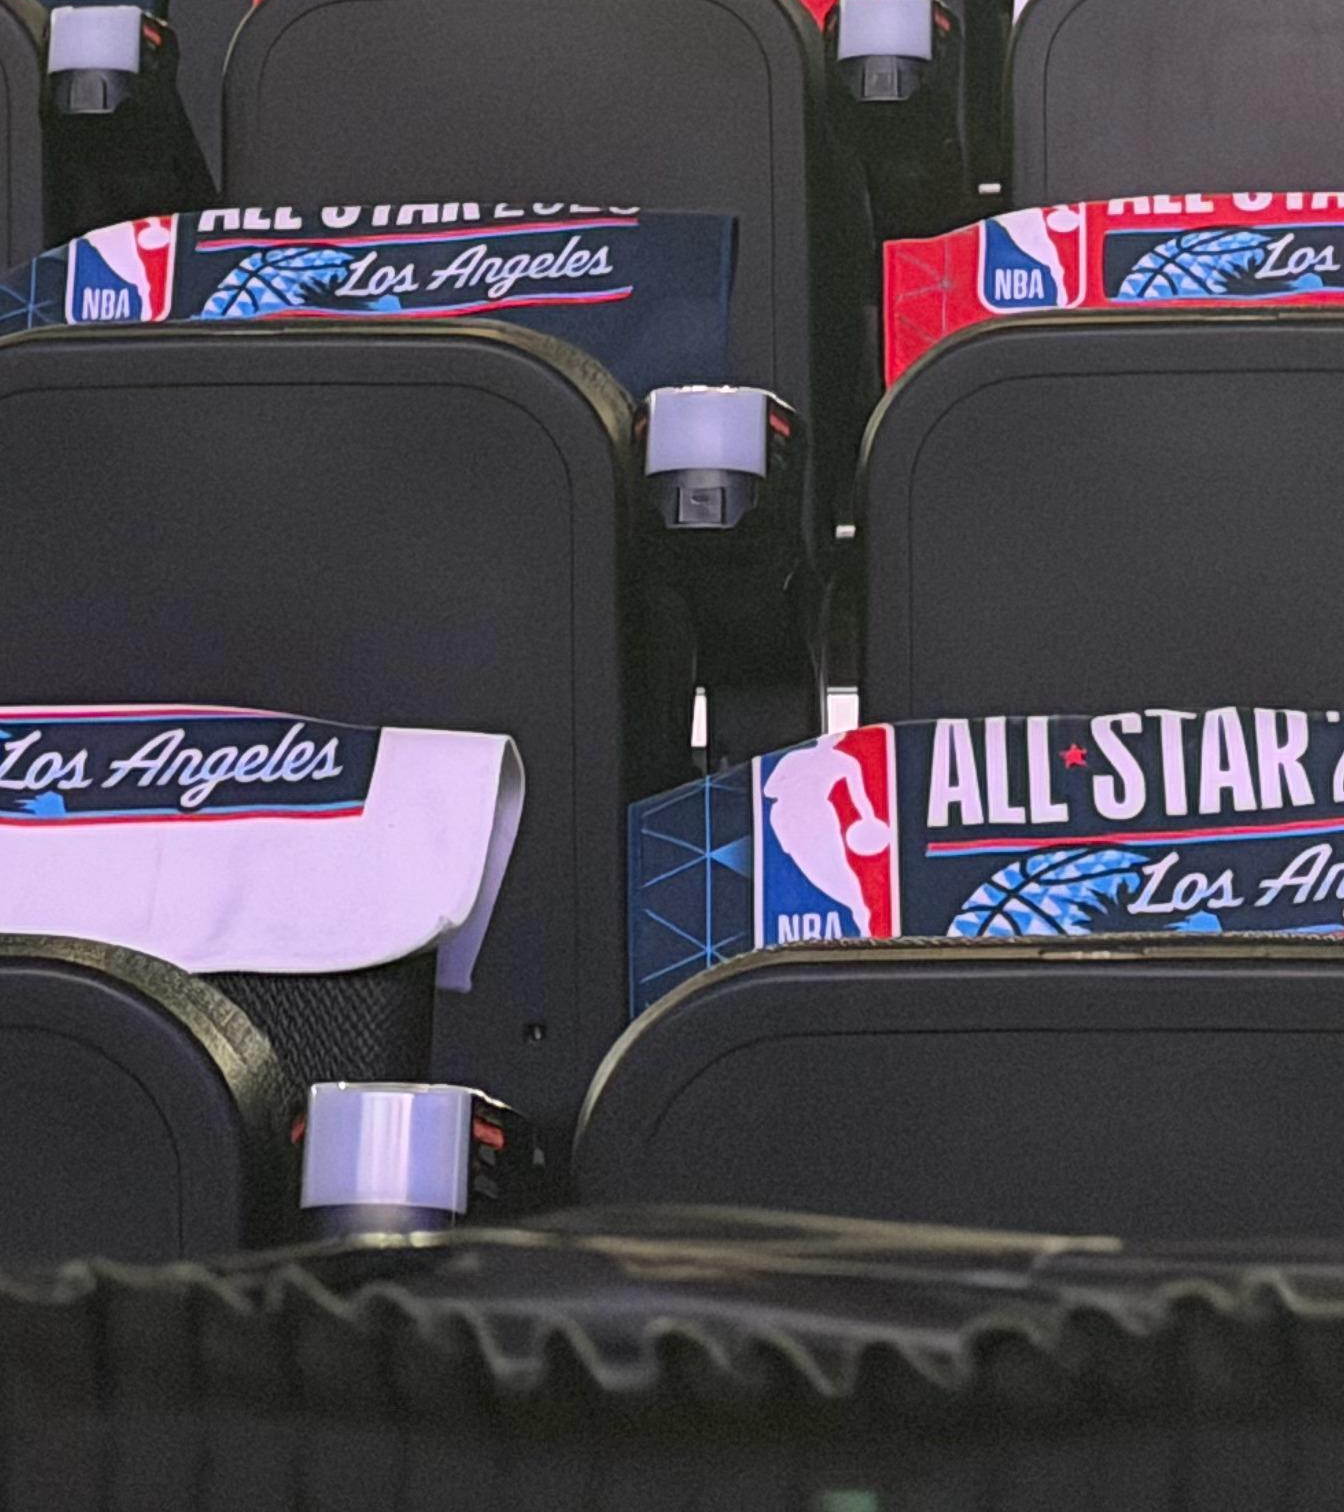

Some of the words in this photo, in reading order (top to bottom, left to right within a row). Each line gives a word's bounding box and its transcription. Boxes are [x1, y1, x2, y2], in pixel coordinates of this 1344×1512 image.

[334, 250, 421, 299] Los
[428, 236, 615, 299] Angeles
[1253, 232, 1342, 279] Los
[80, 286, 132, 320] NBA
[993, 268, 1045, 304] NBA
[101, 720, 343, 809] Angeles
[926, 716, 1070, 829] ALL
[1089, 707, 1315, 820] STAR
[1126, 851, 1245, 916] Los
[777, 913, 843, 944] NBA
